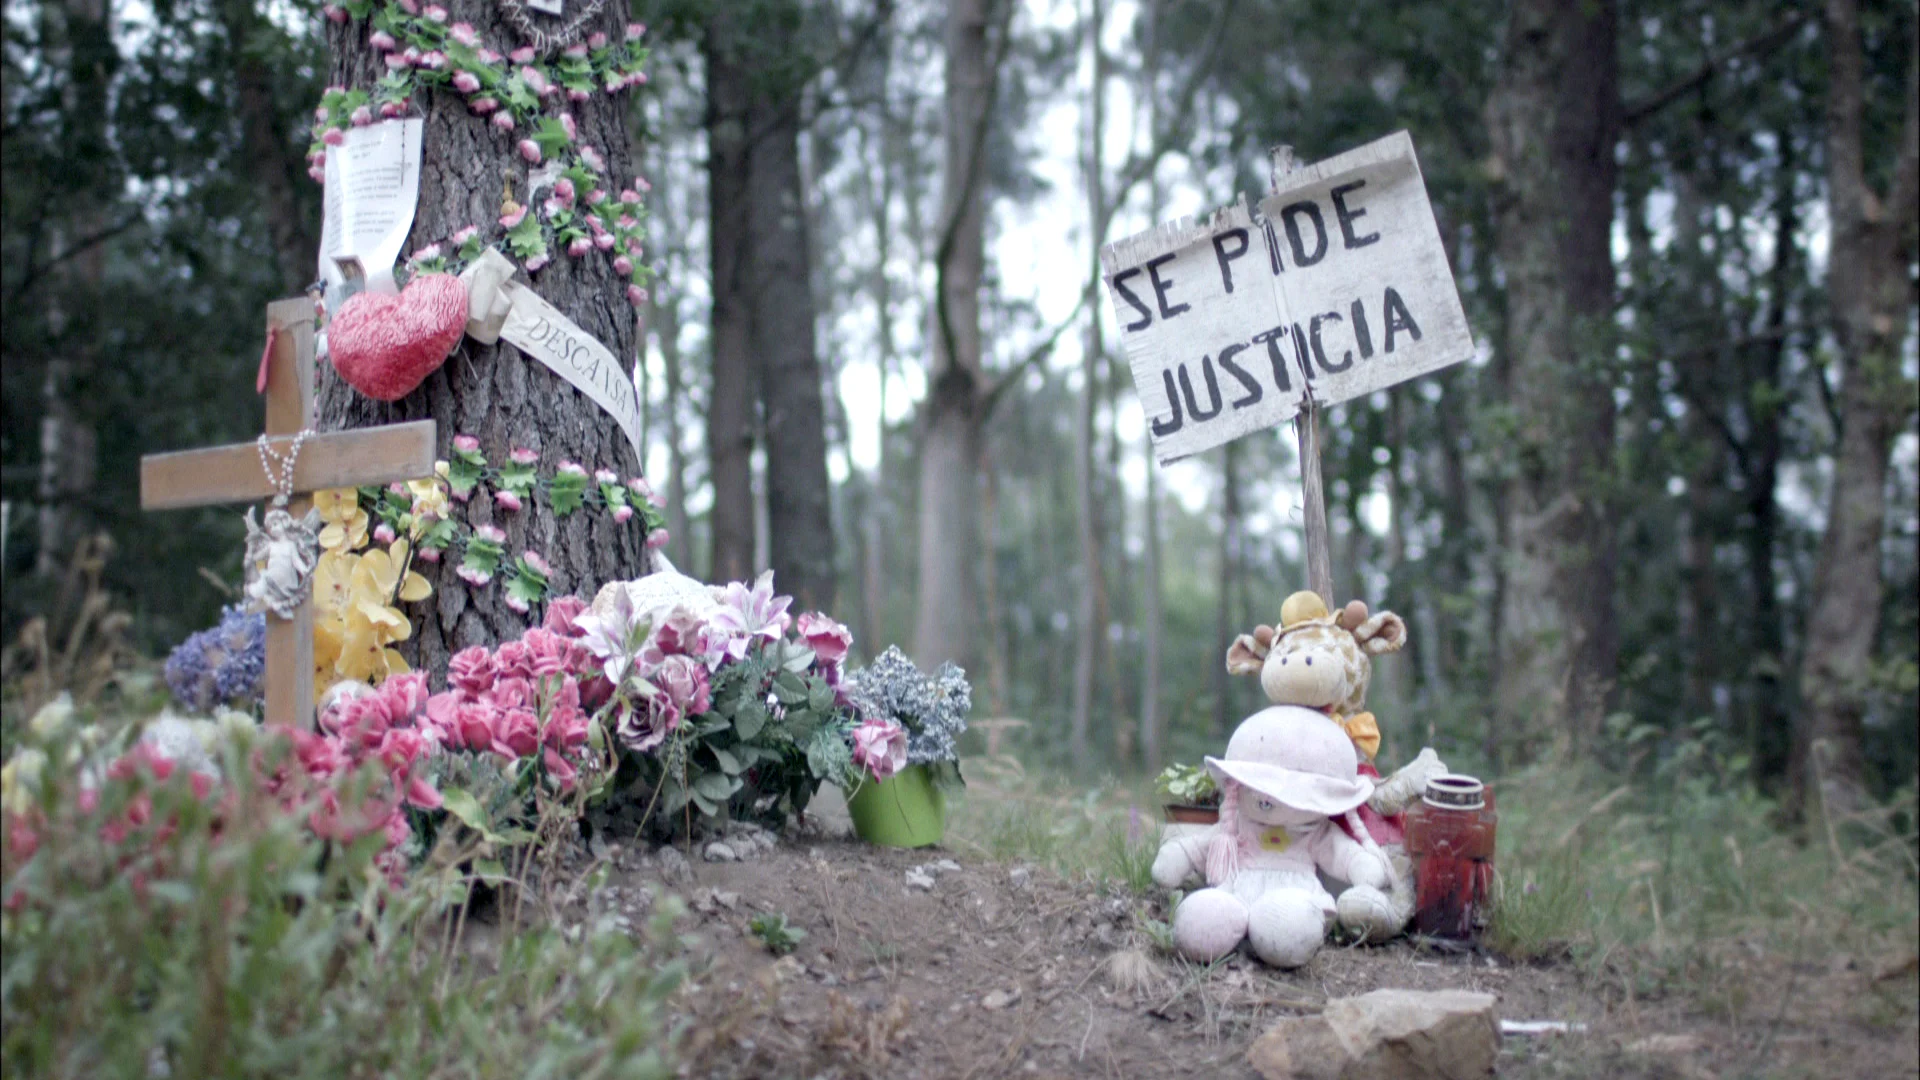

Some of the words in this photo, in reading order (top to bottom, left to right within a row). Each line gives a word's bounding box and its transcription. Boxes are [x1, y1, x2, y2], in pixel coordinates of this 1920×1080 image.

[1113, 252, 1191, 332] SE
[1212, 179, 1380, 293] PIDE
[1152, 286, 1421, 437] JUSTICIA
